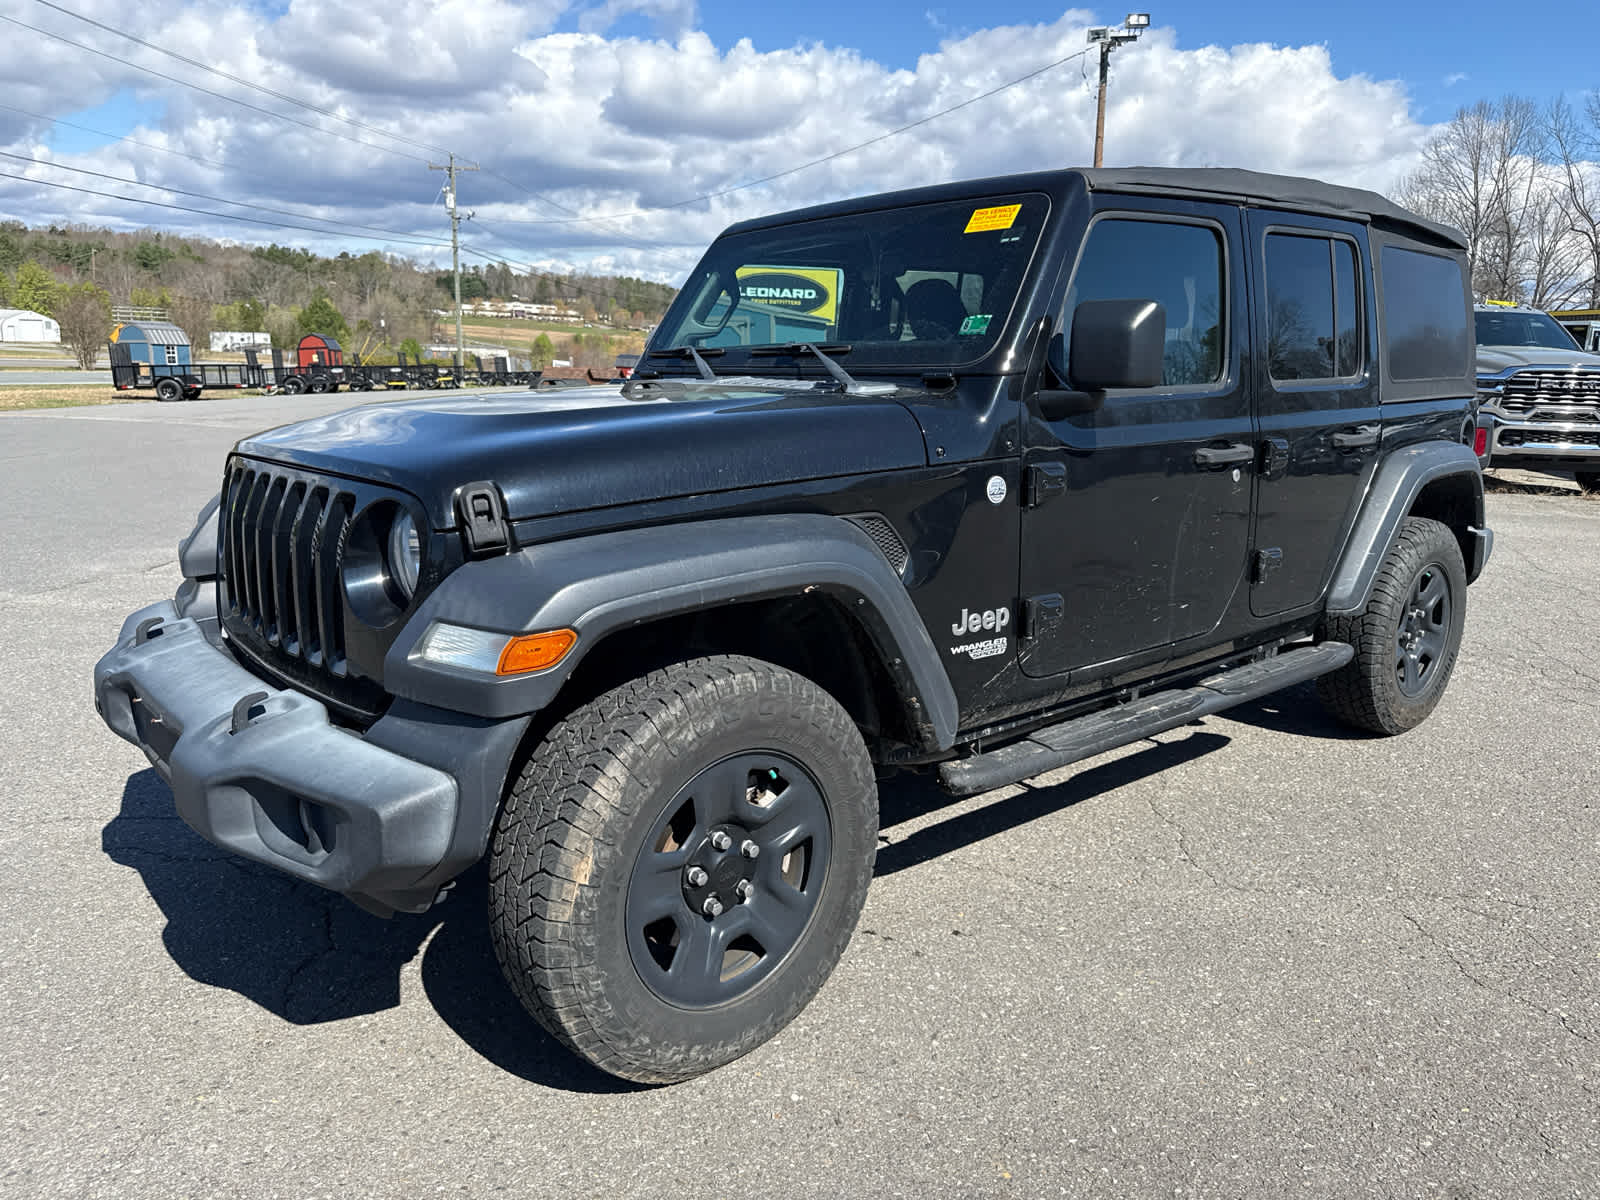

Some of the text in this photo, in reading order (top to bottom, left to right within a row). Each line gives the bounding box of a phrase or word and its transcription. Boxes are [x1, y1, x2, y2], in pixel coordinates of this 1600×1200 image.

[739, 286, 817, 299] LEONARD
[952, 607, 1010, 636] Jeep
[950, 637, 1007, 655] WRANGLER
